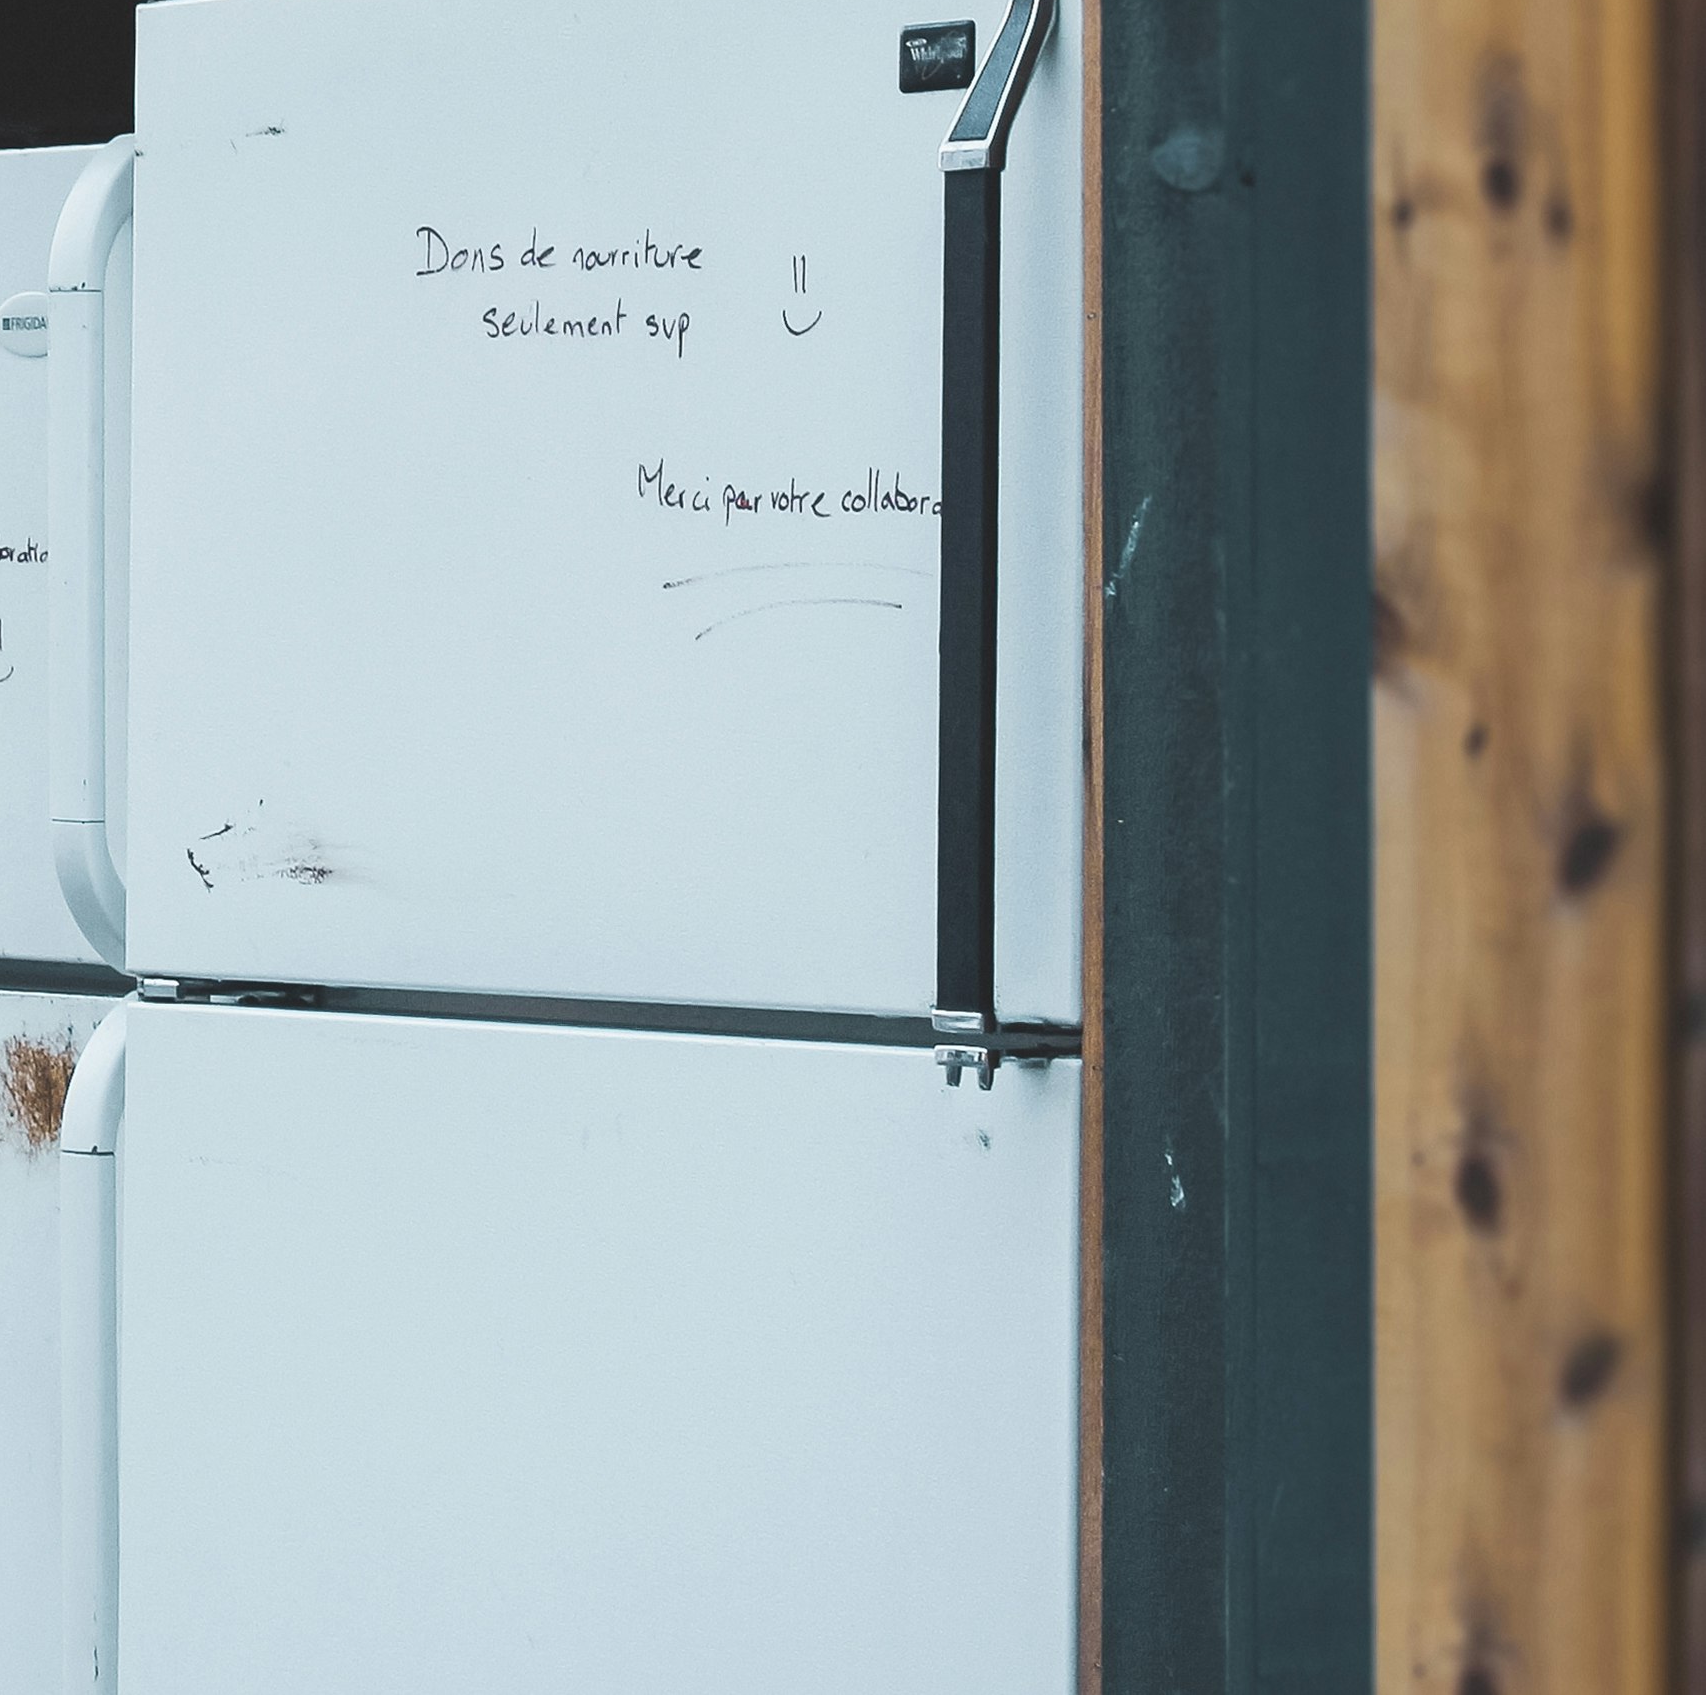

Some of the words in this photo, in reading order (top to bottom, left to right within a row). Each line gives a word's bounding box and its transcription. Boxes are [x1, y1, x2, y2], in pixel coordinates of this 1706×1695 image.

[415, 226, 505, 276] Dons
[520, 226, 556, 271] de
[482, 298, 627, 340] seulement
[638, 458, 710, 514] Merci
[770, 478, 833, 518] votre
